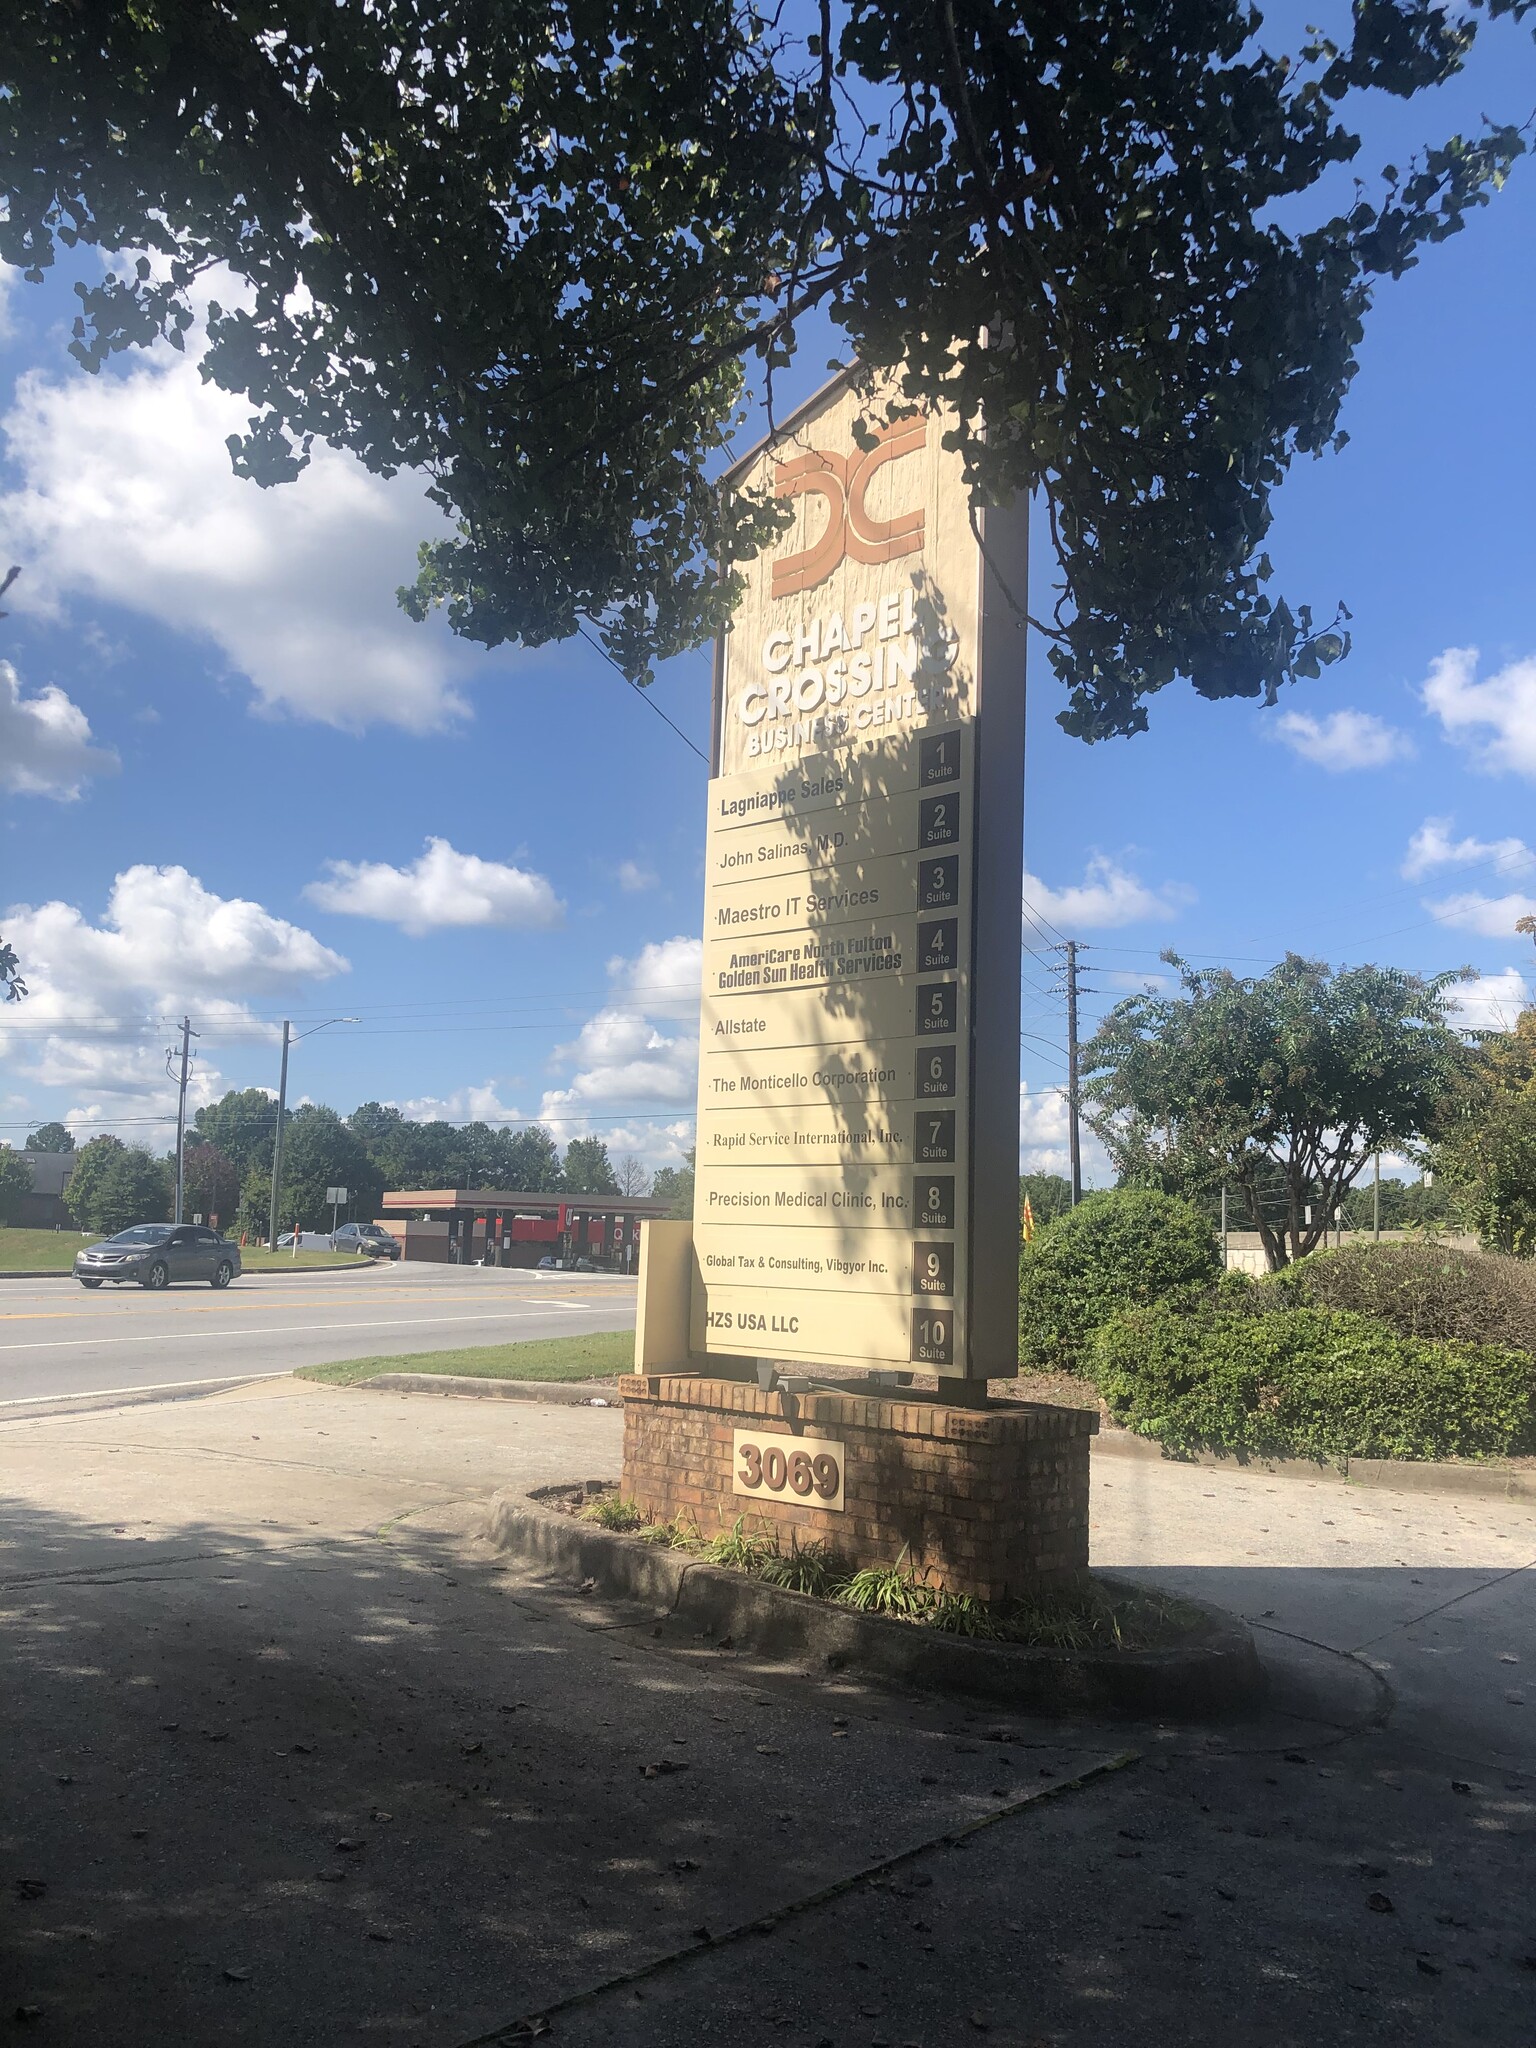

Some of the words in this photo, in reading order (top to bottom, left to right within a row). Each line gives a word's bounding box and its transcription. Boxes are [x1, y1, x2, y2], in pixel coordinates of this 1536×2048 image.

[761, 588, 923, 672] CHAPEL
[739, 622, 960, 726] CROSSING
[748, 711, 850, 757] BUSINESS
[855, 686, 946, 729] CENTER
[936, 742, 946, 764] 1
[927, 766, 953, 779] Suite
[720, 789, 795, 817] Lagniappe
[801, 776, 843, 798] Sales
[934, 804, 946, 828] 2
[927, 828, 952, 841] Suite
[719, 851, 753, 869] John
[757, 841, 812, 862] Salinas,
[817, 832, 849, 850] M.D.
[933, 867, 945, 889] 3
[718, 903, 781, 925] Maestro
[786, 897, 801, 916] IT
[806, 889, 879, 913] Services
[926, 891, 951, 903] Suite
[931, 929, 944, 951] 4
[730, 944, 800, 969] AmeriCare
[804, 939, 845, 959] North
[847, 935, 892, 954] Fulton
[925, 954, 950, 966] Suite
[719, 969, 760, 989] Golden
[763, 966, 787, 983] Sun
[790, 961, 834, 981] Health
[837, 953, 902, 975] Services
[931, 993, 943, 1015] 5
[715, 1018, 766, 1036] Allstate
[924, 1018, 949, 1029] Suite
[930, 1057, 942, 1079] 6
[713, 1077, 736, 1092] The
[740, 1072, 808, 1090] Monticello
[812, 1068, 896, 1088] Corporation
[923, 1081, 948, 1093] Suite
[713, 1133, 745, 1149] Rapid
[749, 1131, 790, 1145] Service
[793, 1130, 875, 1145] International,
[879, 1130, 903, 1143] Inc.
[930, 1122, 942, 1144] 7
[923, 1147, 947, 1158] Suite
[709, 1190, 770, 1207] Precision
[775, 1191, 827, 1207] Medical
[831, 1191, 877, 1210] Clinic,
[881, 1192, 908, 1208] Inc.
[928, 1187, 941, 1209] 8
[921, 1213, 946, 1224] Suite
[706, 1255, 735, 1267] Global
[738, 1256, 755, 1268] Tax
[758, 1257, 765, 1268] &
[768, 1257, 823, 1273] Consulting,
[826, 1259, 865, 1276] Vibgyor
[868, 1260, 888, 1273] Inc.
[927, 1253, 940, 1276] 9
[920, 1279, 946, 1290] Suite
[706, 1312, 733, 1328] HZS
[737, 1313, 767, 1331] USA
[771, 1315, 799, 1333] LLC
[920, 1320, 945, 1345] 10
[919, 1347, 945, 1359] Suite
[733, 1444, 859, 1499] 3069
